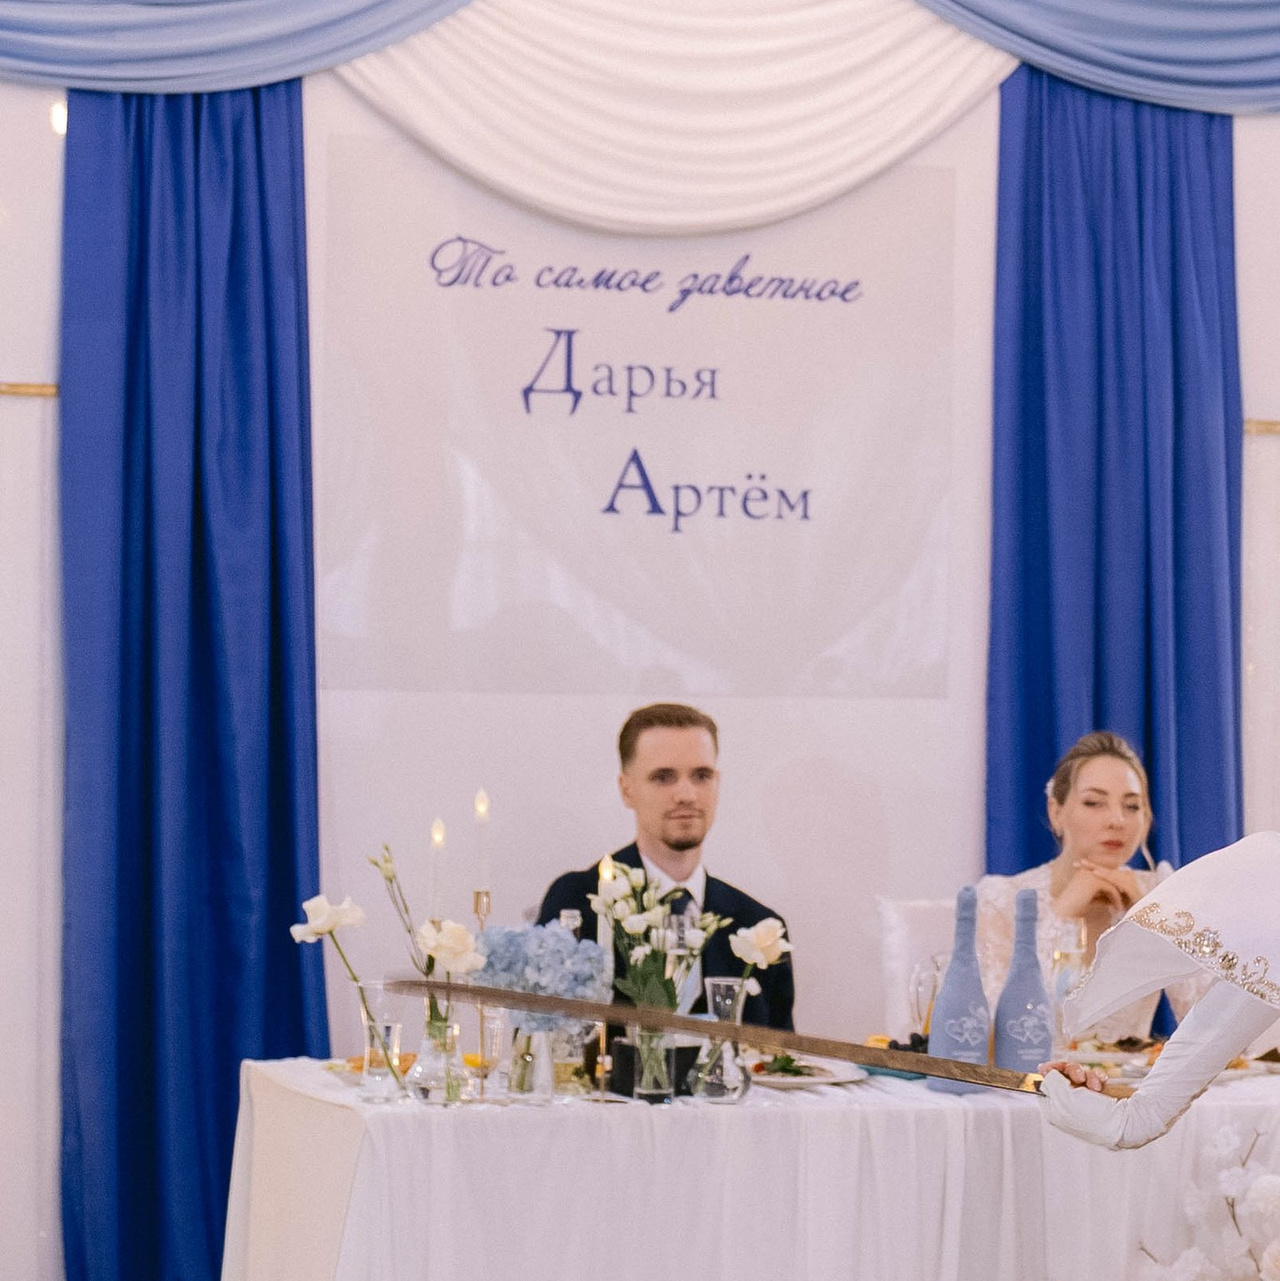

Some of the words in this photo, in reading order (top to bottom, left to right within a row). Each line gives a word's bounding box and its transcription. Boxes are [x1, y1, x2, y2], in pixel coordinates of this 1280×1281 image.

[429, 235, 518, 289] То
[534, 261, 663, 294] самое
[667, 253, 863, 313] заветное
[520, 327, 721, 416] Дарья
[601, 447, 813, 533] Артём
